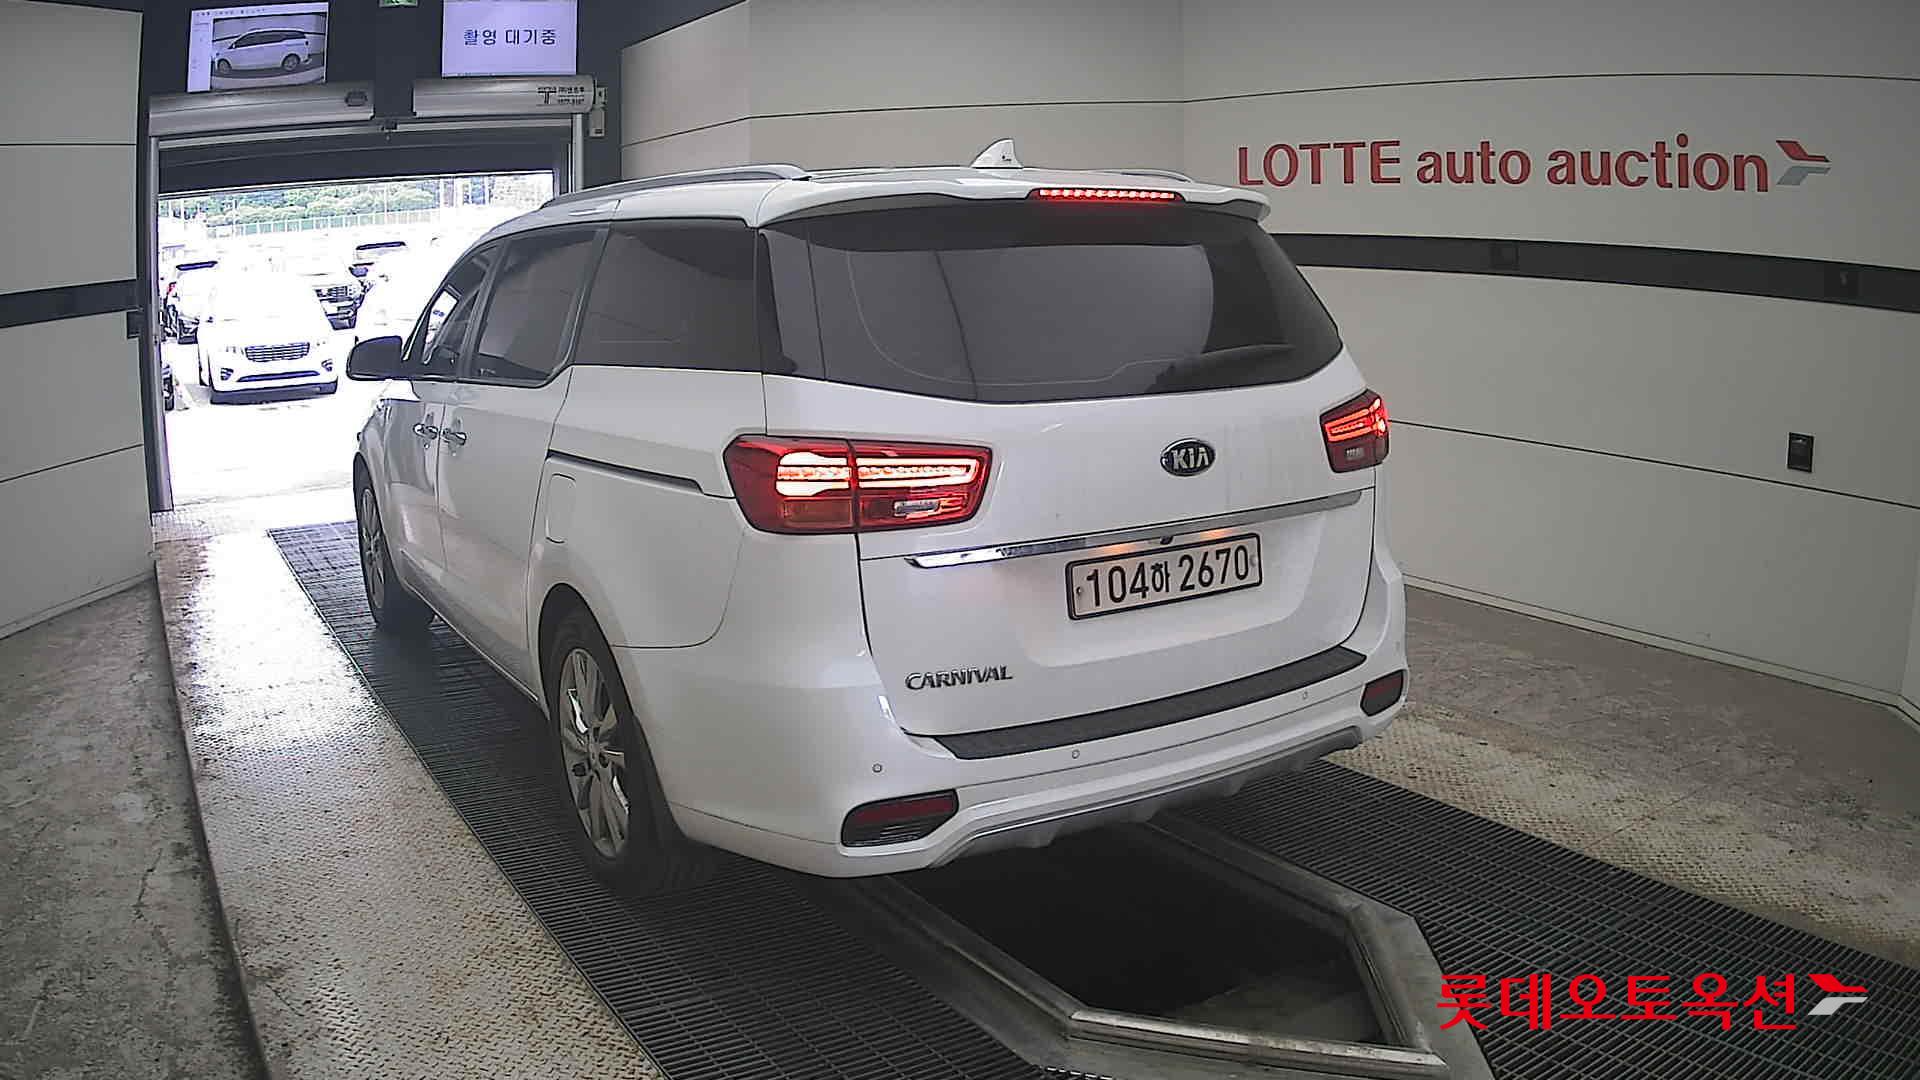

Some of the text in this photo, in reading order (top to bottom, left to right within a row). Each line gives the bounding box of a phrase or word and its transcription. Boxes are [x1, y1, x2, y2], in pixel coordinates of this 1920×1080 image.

[463, 29, 557, 46] 촬영 대기중
[1237, 133, 1769, 193] LOTTE auto auction
[1170, 446, 1210, 470] KIA
[1085, 544, 1251, 607] 104하 2670
[905, 665, 1014, 691] CARNIVAL
